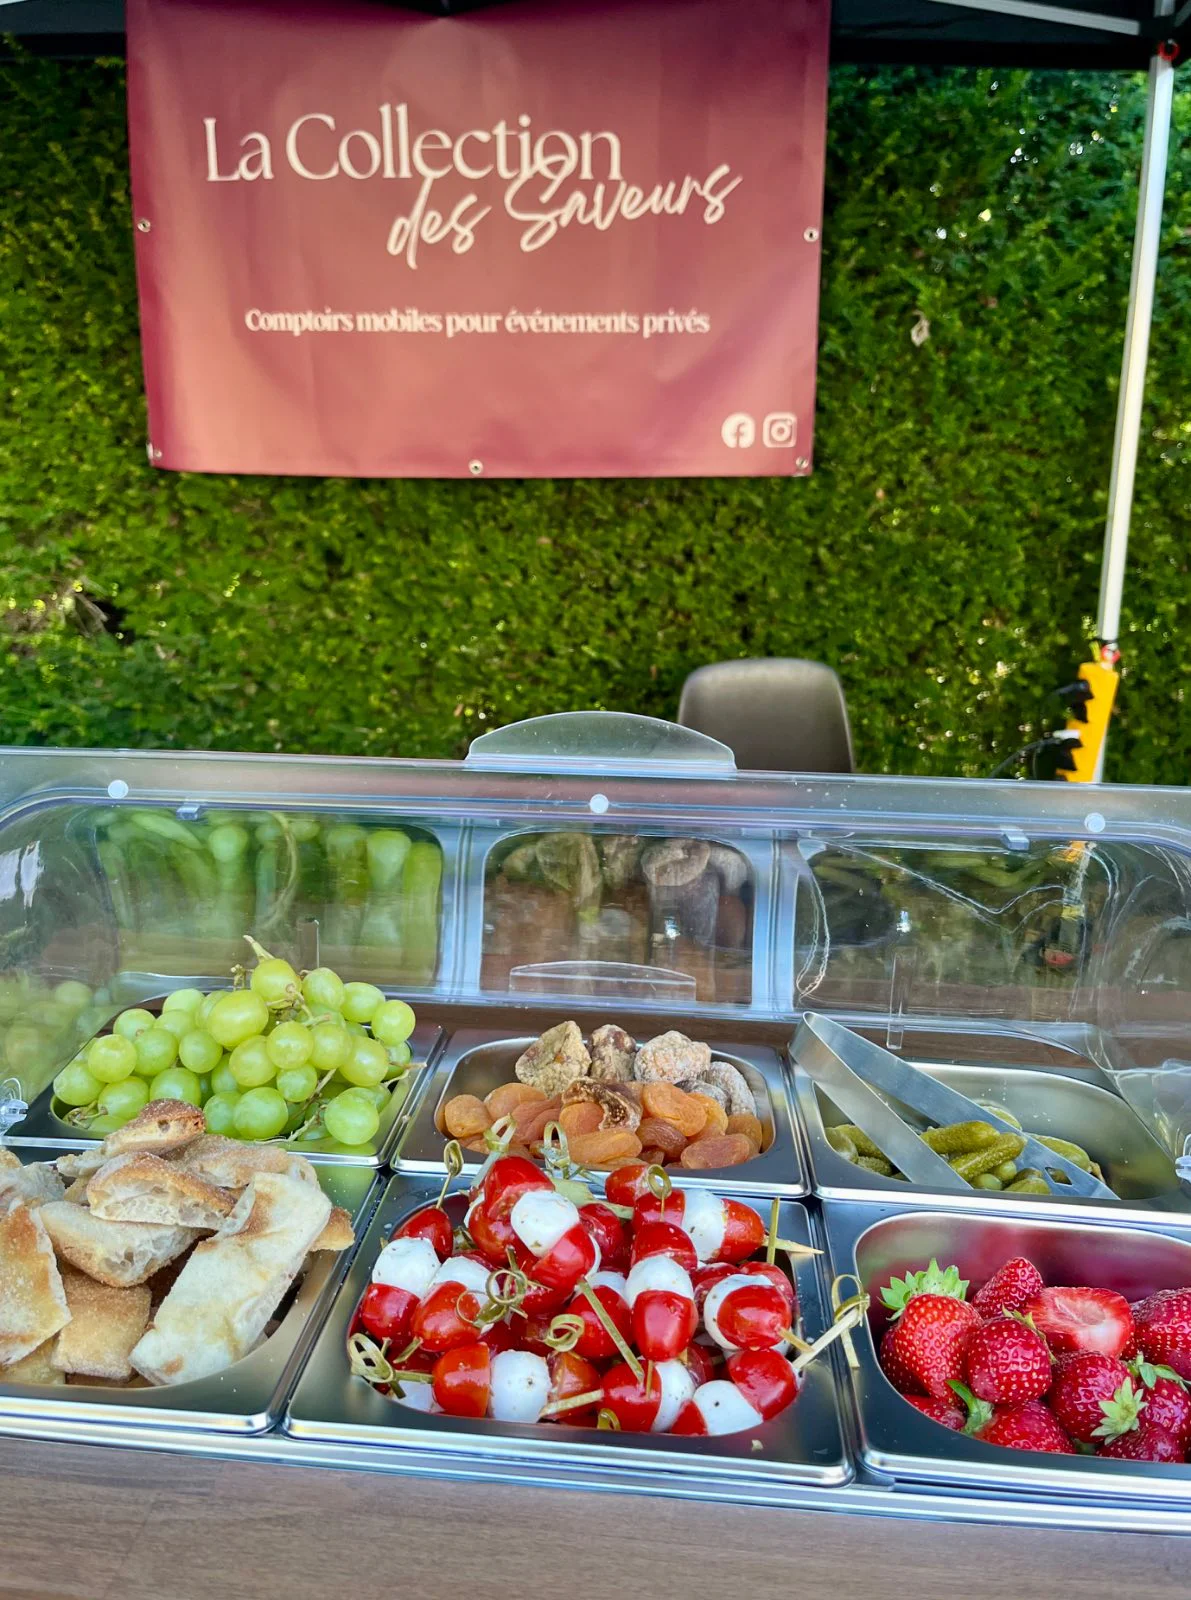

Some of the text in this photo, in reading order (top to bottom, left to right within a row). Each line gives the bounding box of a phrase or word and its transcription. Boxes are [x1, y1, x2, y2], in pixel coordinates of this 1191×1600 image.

[203, 102, 623, 182] La Collection
[387, 154, 743, 270] des Saveurs
[244, 307, 711, 339] Comptoirs mobiles pour événements privés
